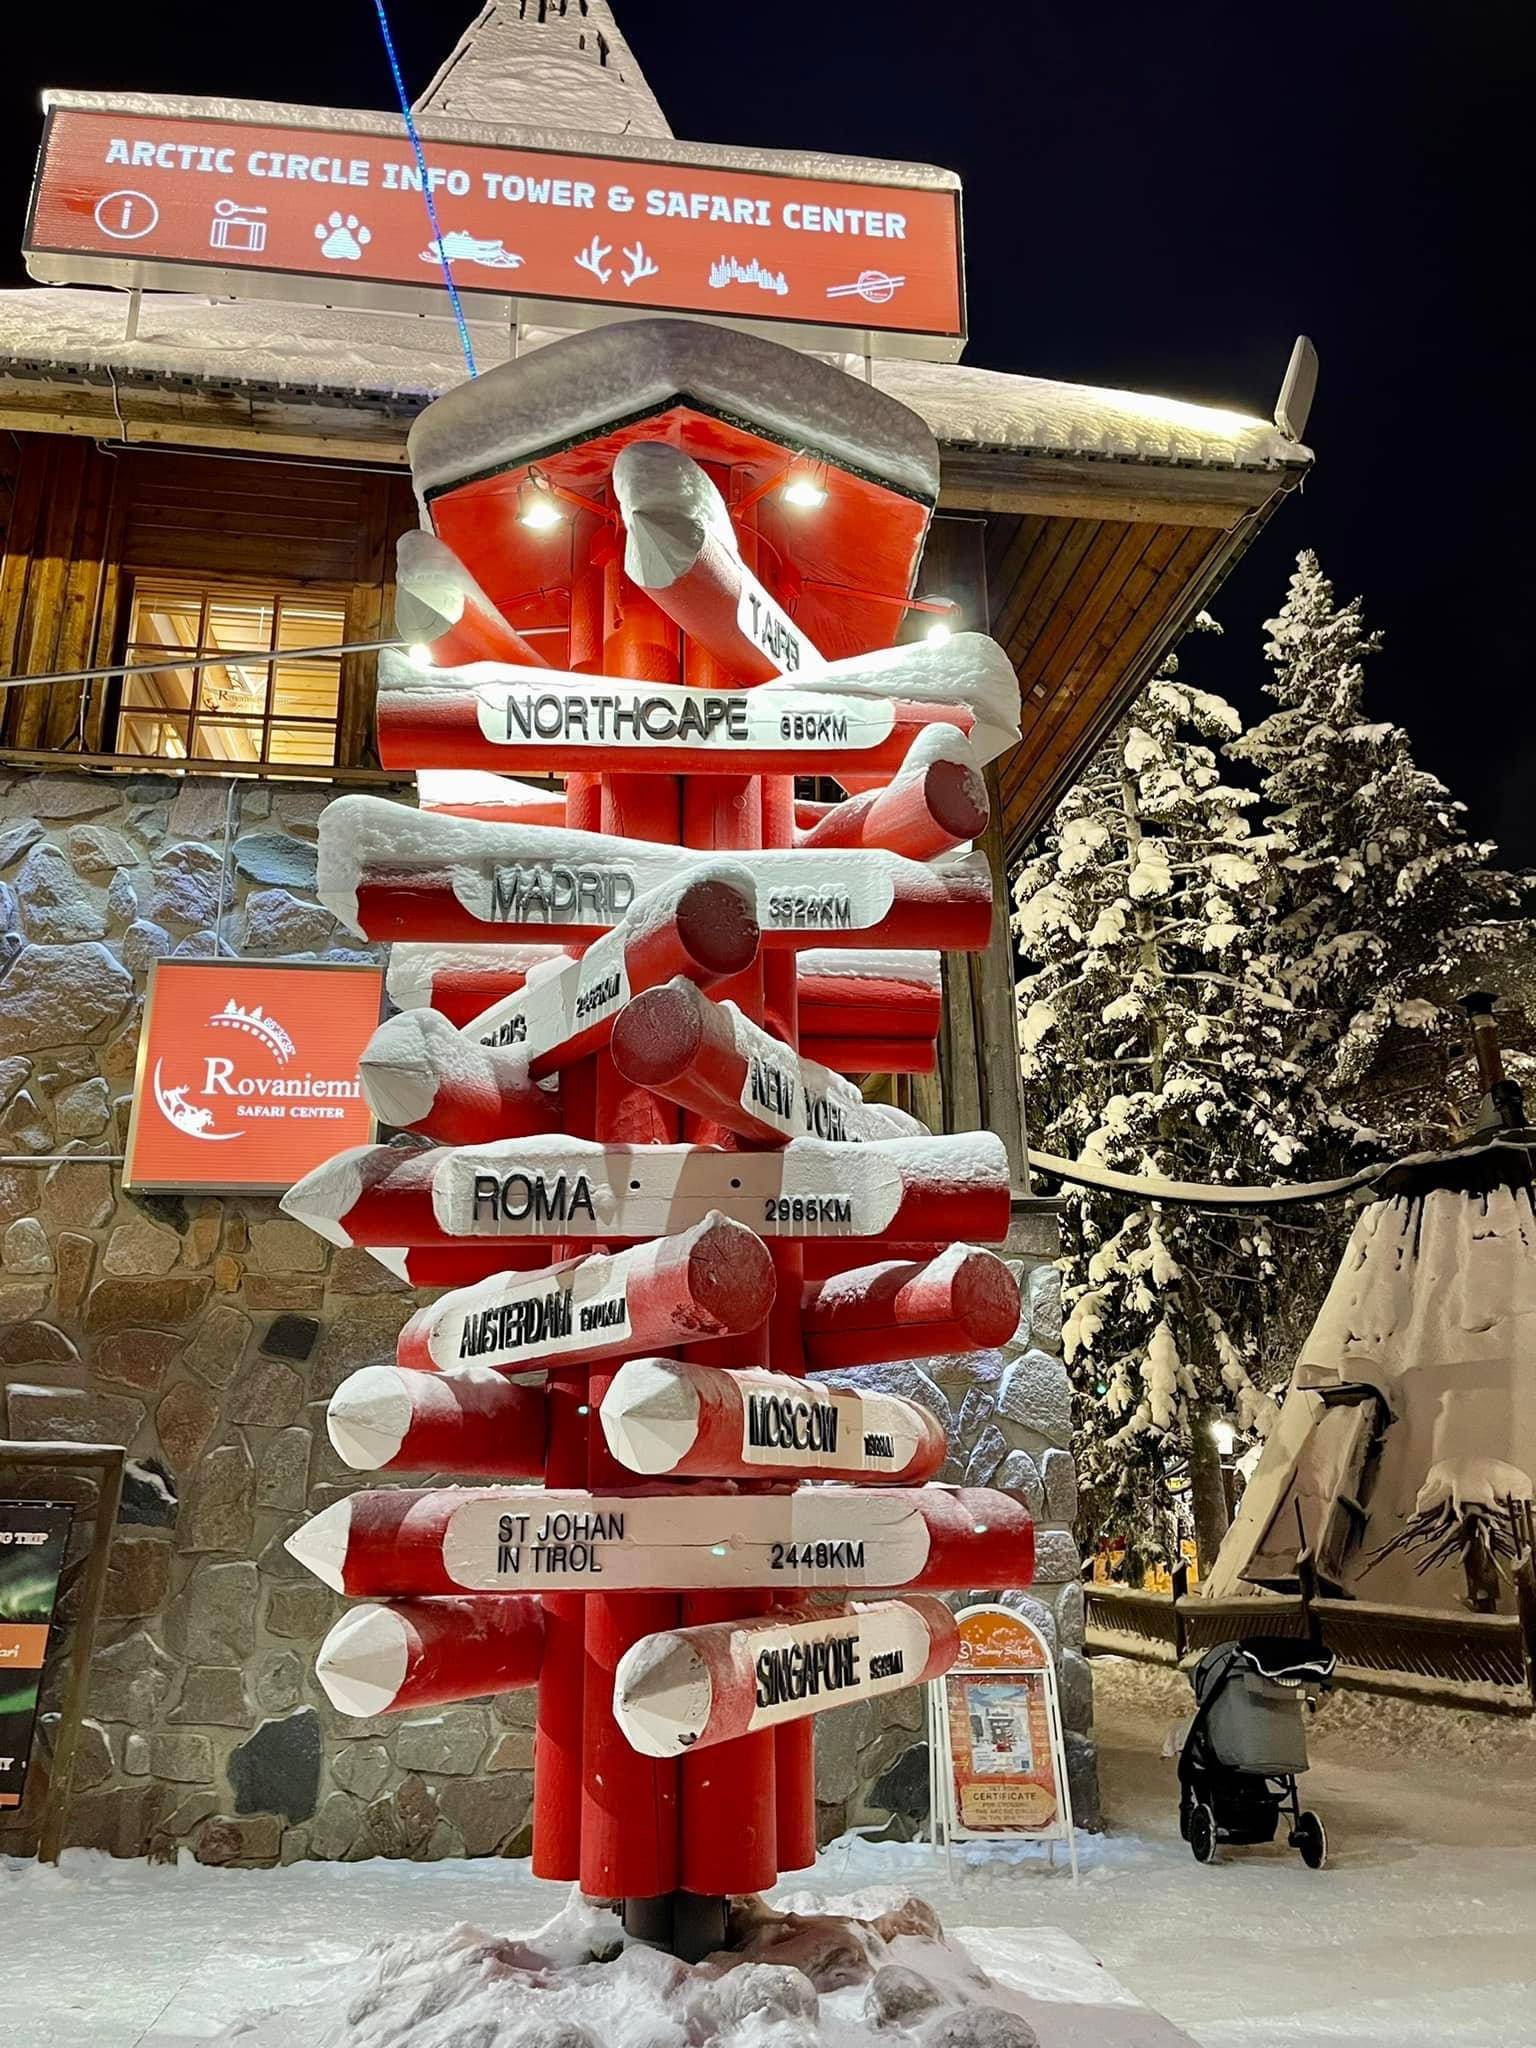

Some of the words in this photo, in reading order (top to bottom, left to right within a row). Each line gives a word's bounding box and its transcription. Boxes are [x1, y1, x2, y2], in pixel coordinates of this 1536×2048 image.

[105, 138, 236, 174] ARCTIC
[248, 150, 369, 187] CIRCLE
[382, 162, 471, 196] INFO
[482, 172, 596, 209] TOWER
[607, 185, 635, 213] &
[646, 190, 772, 227] SAFARI
[783, 202, 907, 239] CENTER
[505, 695, 749, 741] NORTHCAPE
[490, 863, 635, 920] MADRID
[200, 1056, 361, 1098] Rovaniemi
[236, 1105, 285, 1118] SAFARI
[289, 1106, 345, 1119] CENTER
[472, 1174, 596, 1222] ROMA
[764, 1199, 852, 1223] 2985KM
[459, 1288, 575, 1359] AMSTERDAM
[748, 1394, 839, 1453] MOSCOW
[497, 1514, 531, 1543] ST
[537, 1513, 625, 1542] JOHAN
[497, 1545, 520, 1574] IN
[531, 1544, 603, 1574] TIROL
[771, 1541, 866, 1569] 2448KM
[756, 1635, 861, 1709] SINGAPORE
[973, 1792, 1037, 1801] CERTIFICATE
